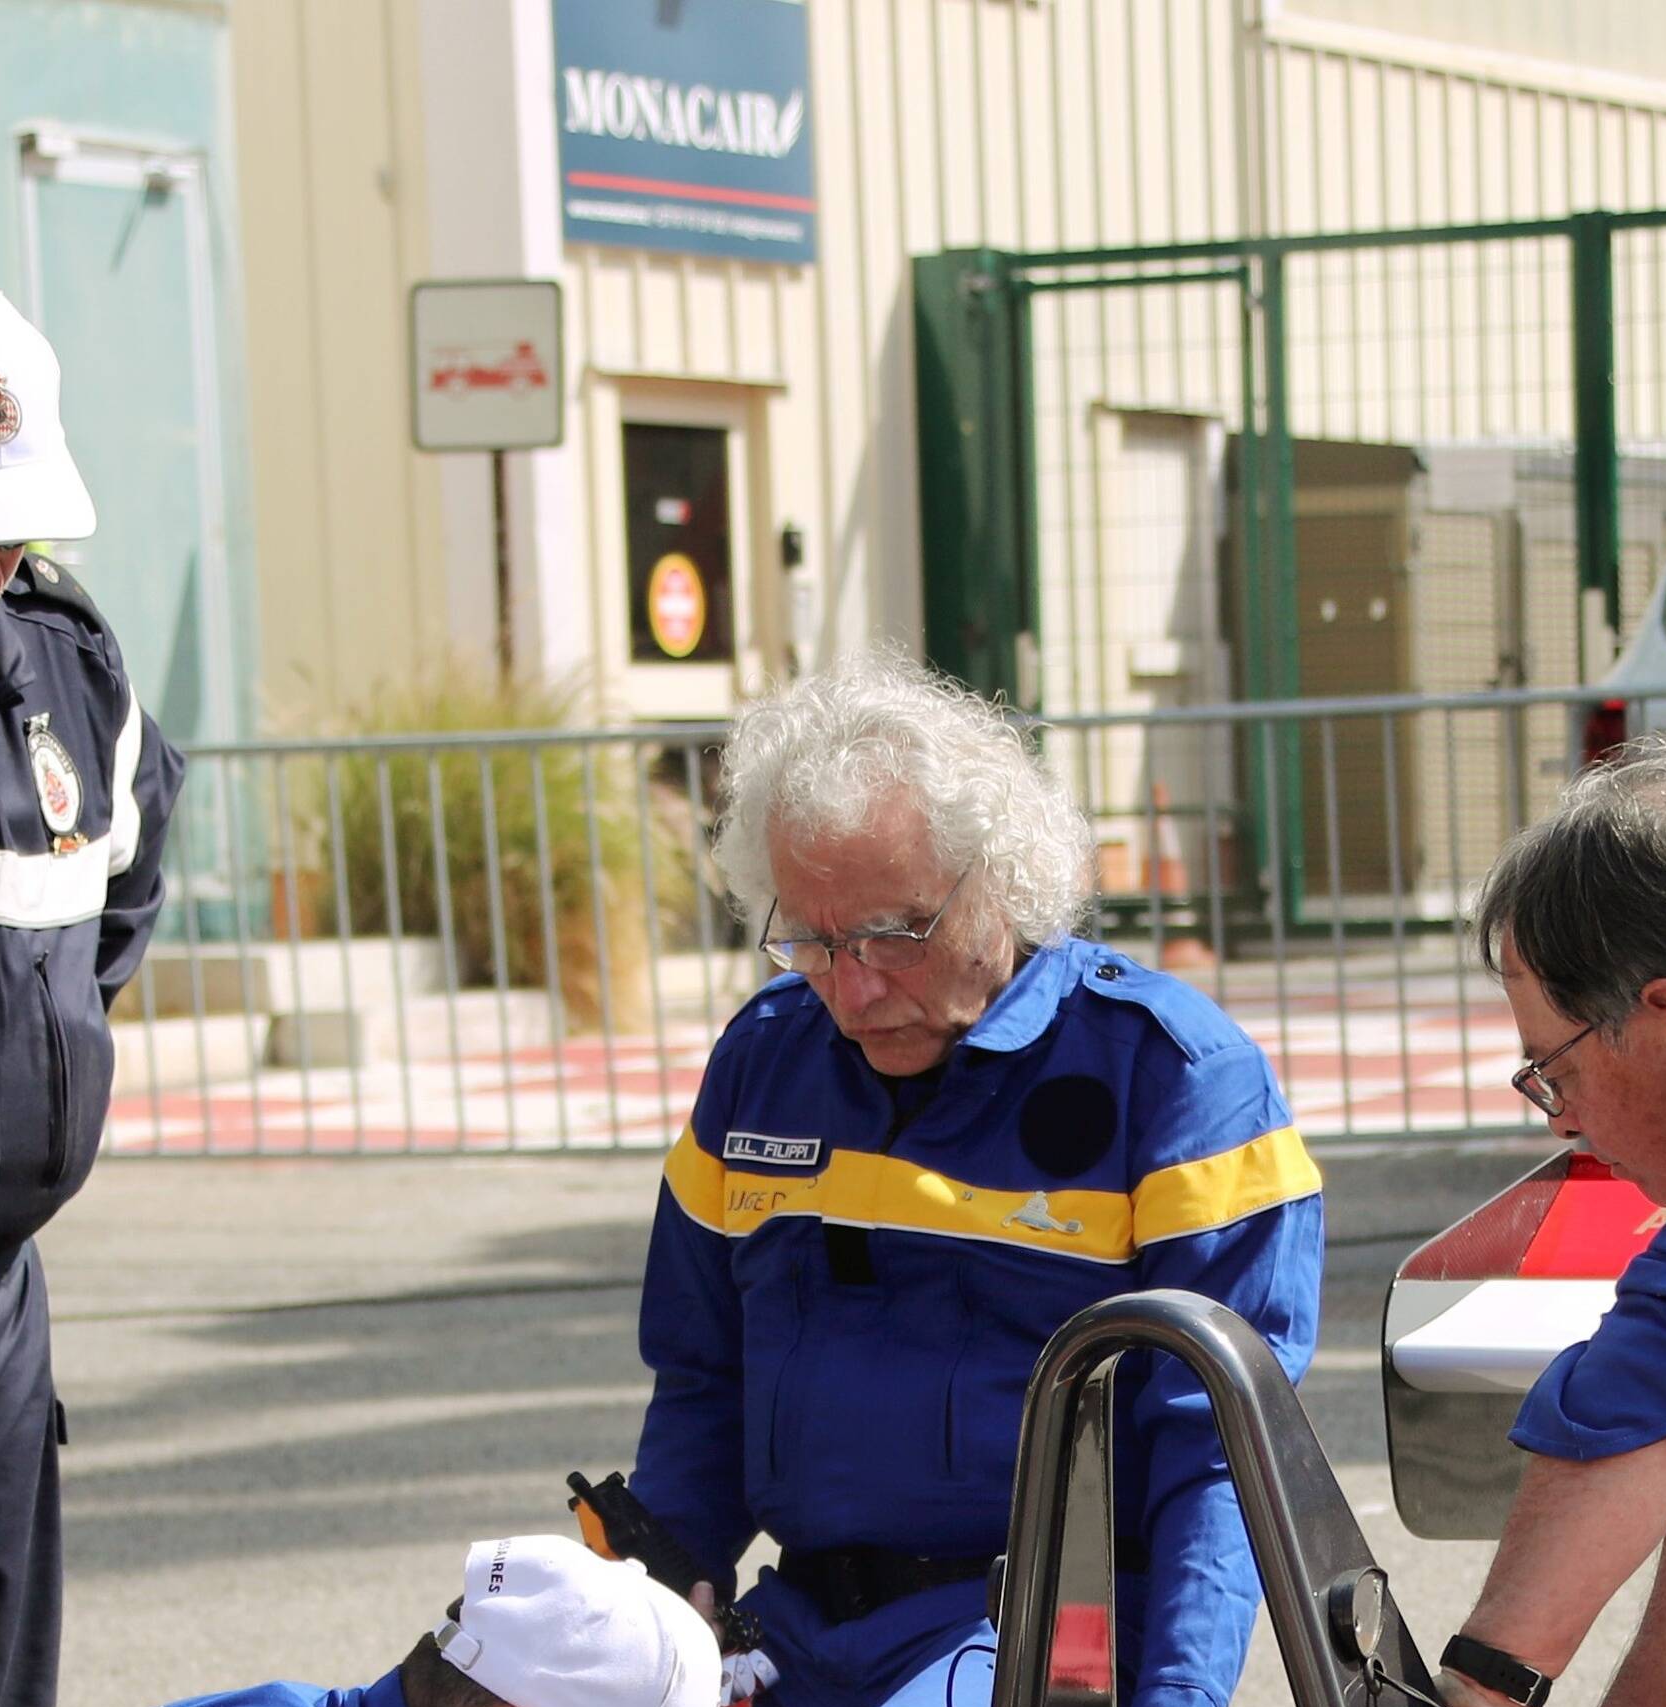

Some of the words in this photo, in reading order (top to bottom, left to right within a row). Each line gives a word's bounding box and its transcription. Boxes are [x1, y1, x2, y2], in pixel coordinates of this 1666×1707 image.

[563, 67, 786, 160] MONACAIR
[734, 1138, 757, 1155] J.L.
[764, 1142, 809, 1159] FILIPPI
